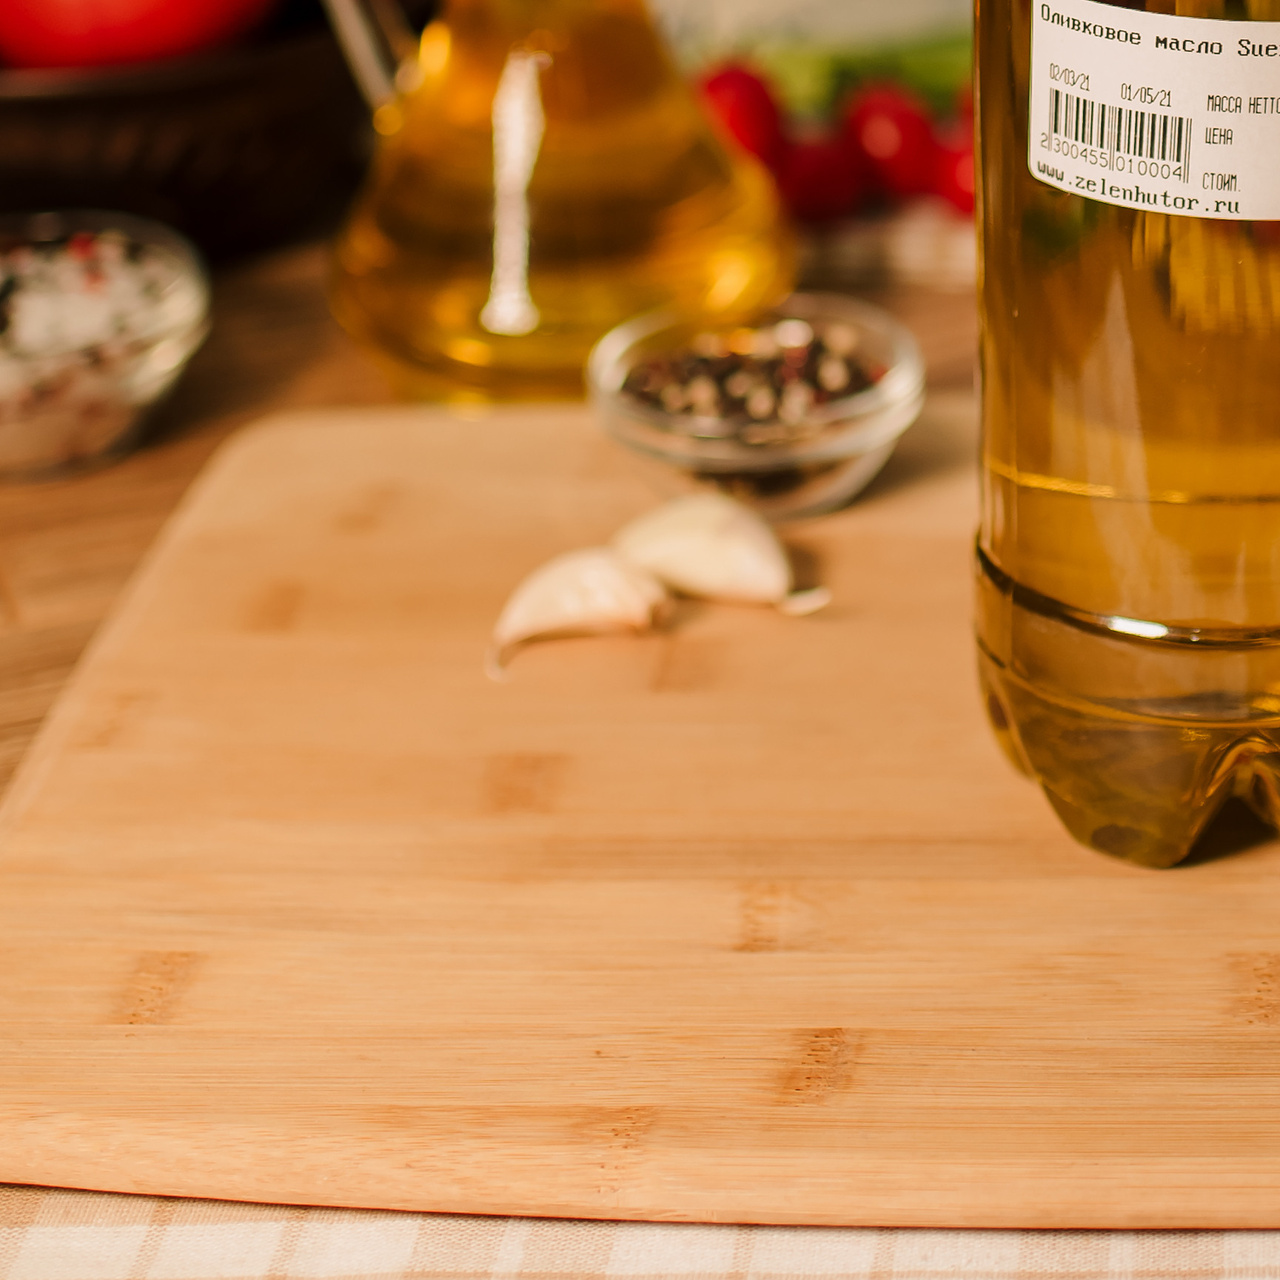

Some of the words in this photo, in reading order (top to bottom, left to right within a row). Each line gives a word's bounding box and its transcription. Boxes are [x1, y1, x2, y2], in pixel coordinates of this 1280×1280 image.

[1041, 3, 1141, 45] Оливковое
[1155, 35, 1222, 55] масло
[1049, 62, 1091, 91] 02/03/21
[1121, 82, 1172, 107] 01/05/21
[1207, 94, 1242, 114] МАССА
[1205, 127, 1233, 145] ЦЕНА
[1037, 160, 1240, 213] www.zelenhutor.ru
